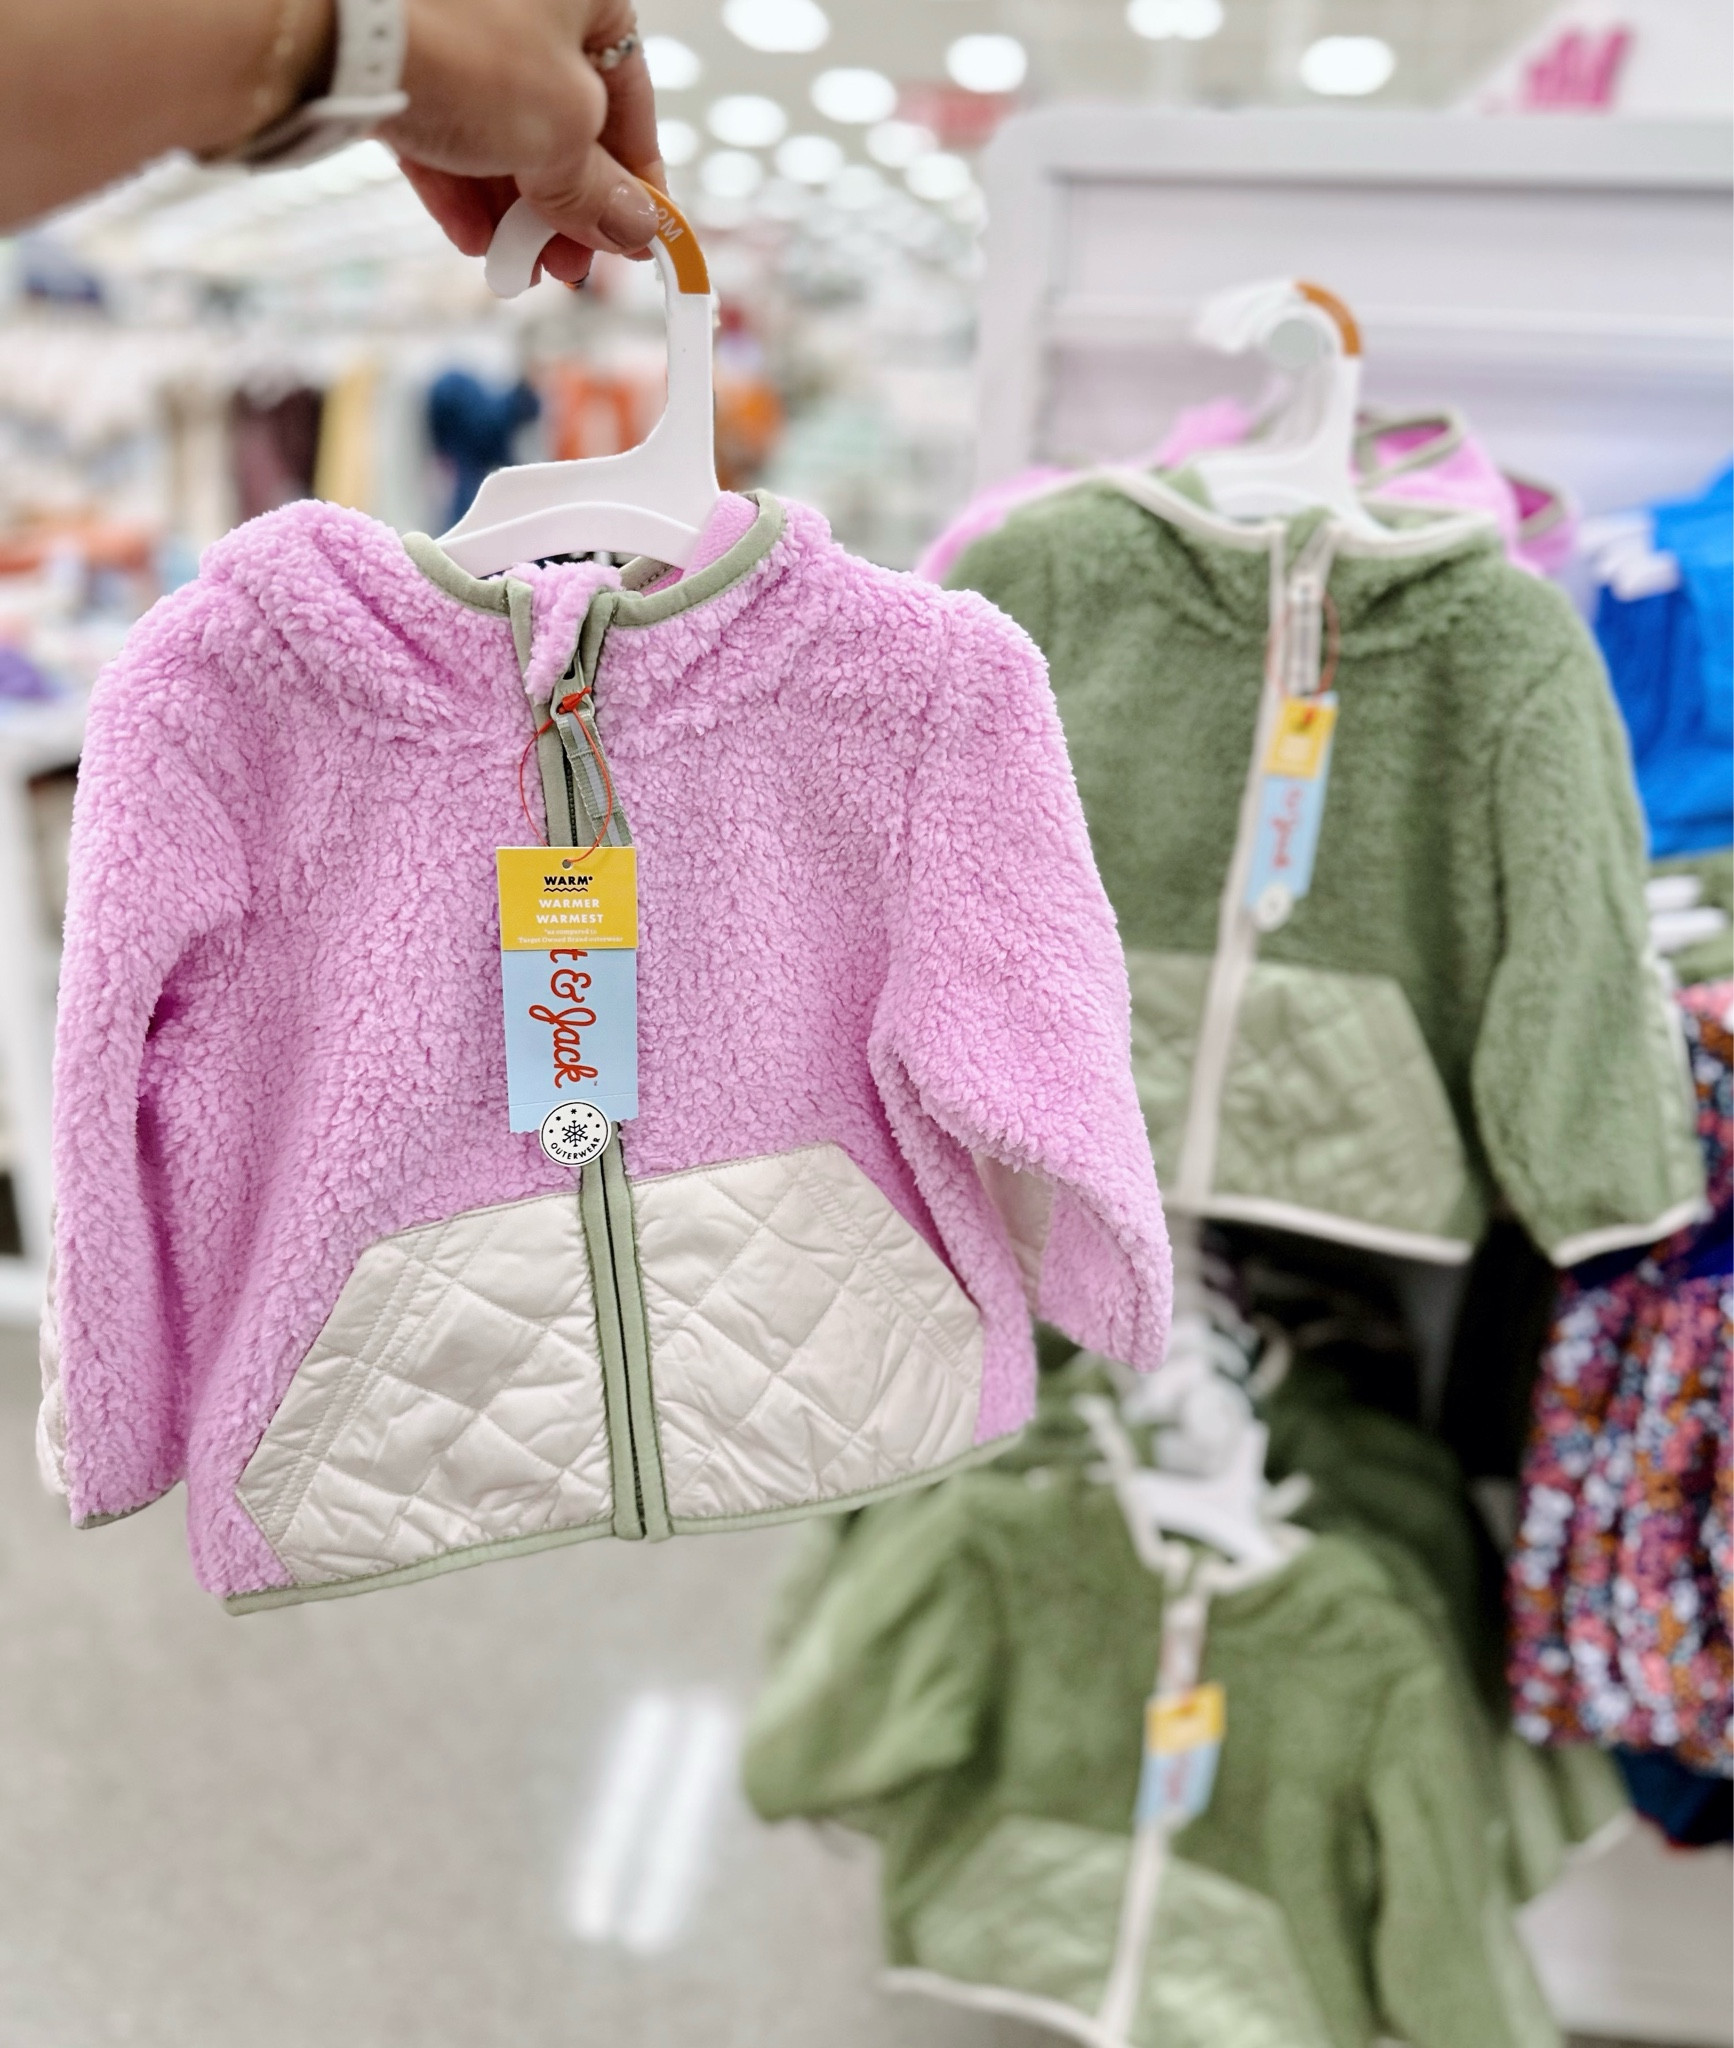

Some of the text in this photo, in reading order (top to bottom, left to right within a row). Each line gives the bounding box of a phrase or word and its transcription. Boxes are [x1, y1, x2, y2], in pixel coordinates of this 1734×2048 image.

[539, 898, 600, 908] WARMER
[536, 914, 604, 924] WARMEST
[550, 968, 592, 1003] &
[528, 1004, 599, 1089] Jack
[550, 1137, 601, 1160] OUTERWEAR
